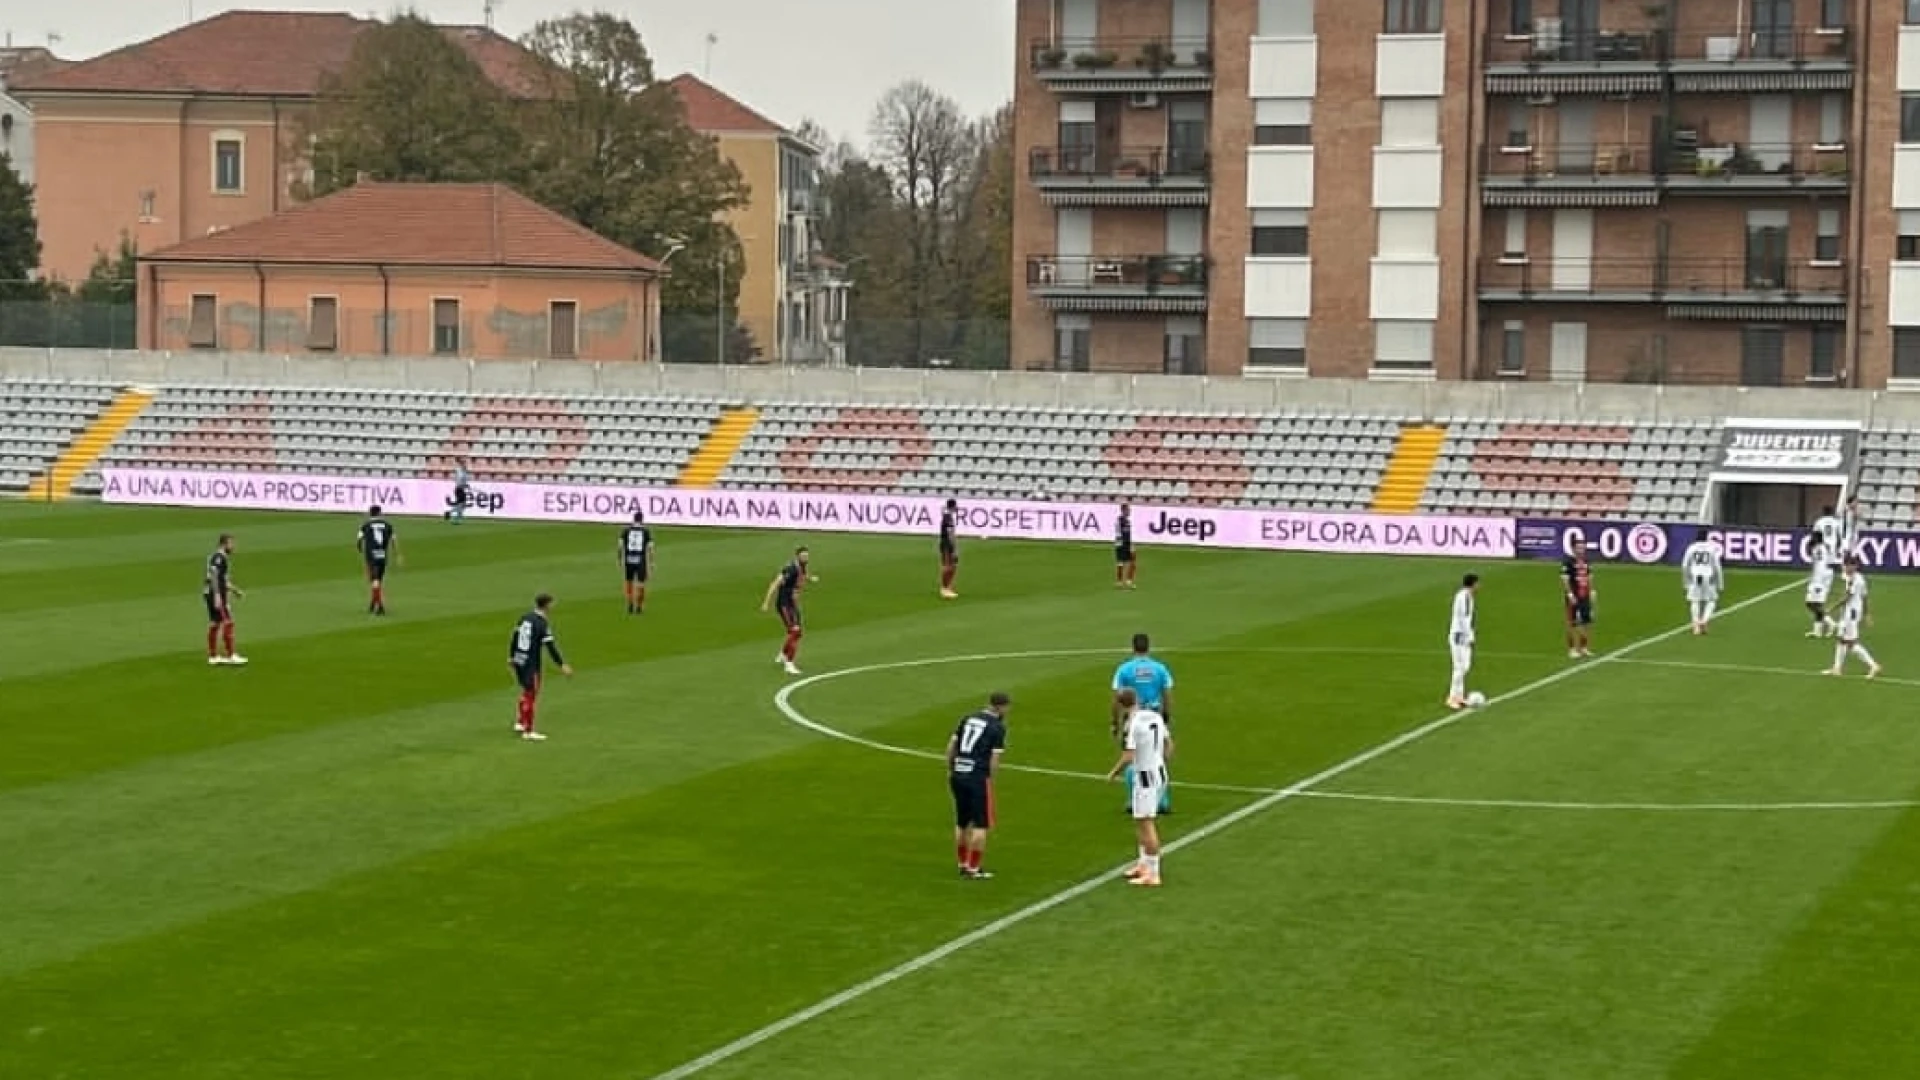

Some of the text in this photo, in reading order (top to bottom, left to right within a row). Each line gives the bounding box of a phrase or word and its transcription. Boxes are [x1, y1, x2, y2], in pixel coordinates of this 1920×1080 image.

[1730, 432, 1844, 449] JUVENTUS
[127, 476, 175, 497] UNA
[180, 478, 260, 501] NUOVA
[263, 481, 404, 506] PROSPETTIVA
[543, 490, 1101, 533] ESPLORA DA UNA NA UNA NUOVA ROSPETTIVA
[1149, 510, 1216, 540] Jeep
[1261, 517, 1377, 545] ESPLORA
[1385, 523, 1423, 546] DA
[1431, 524, 1492, 549] UNA
[1706, 531, 1793, 561] SERIE
[960, 718, 987, 752] 17
[1149, 722, 1159, 748] 7
